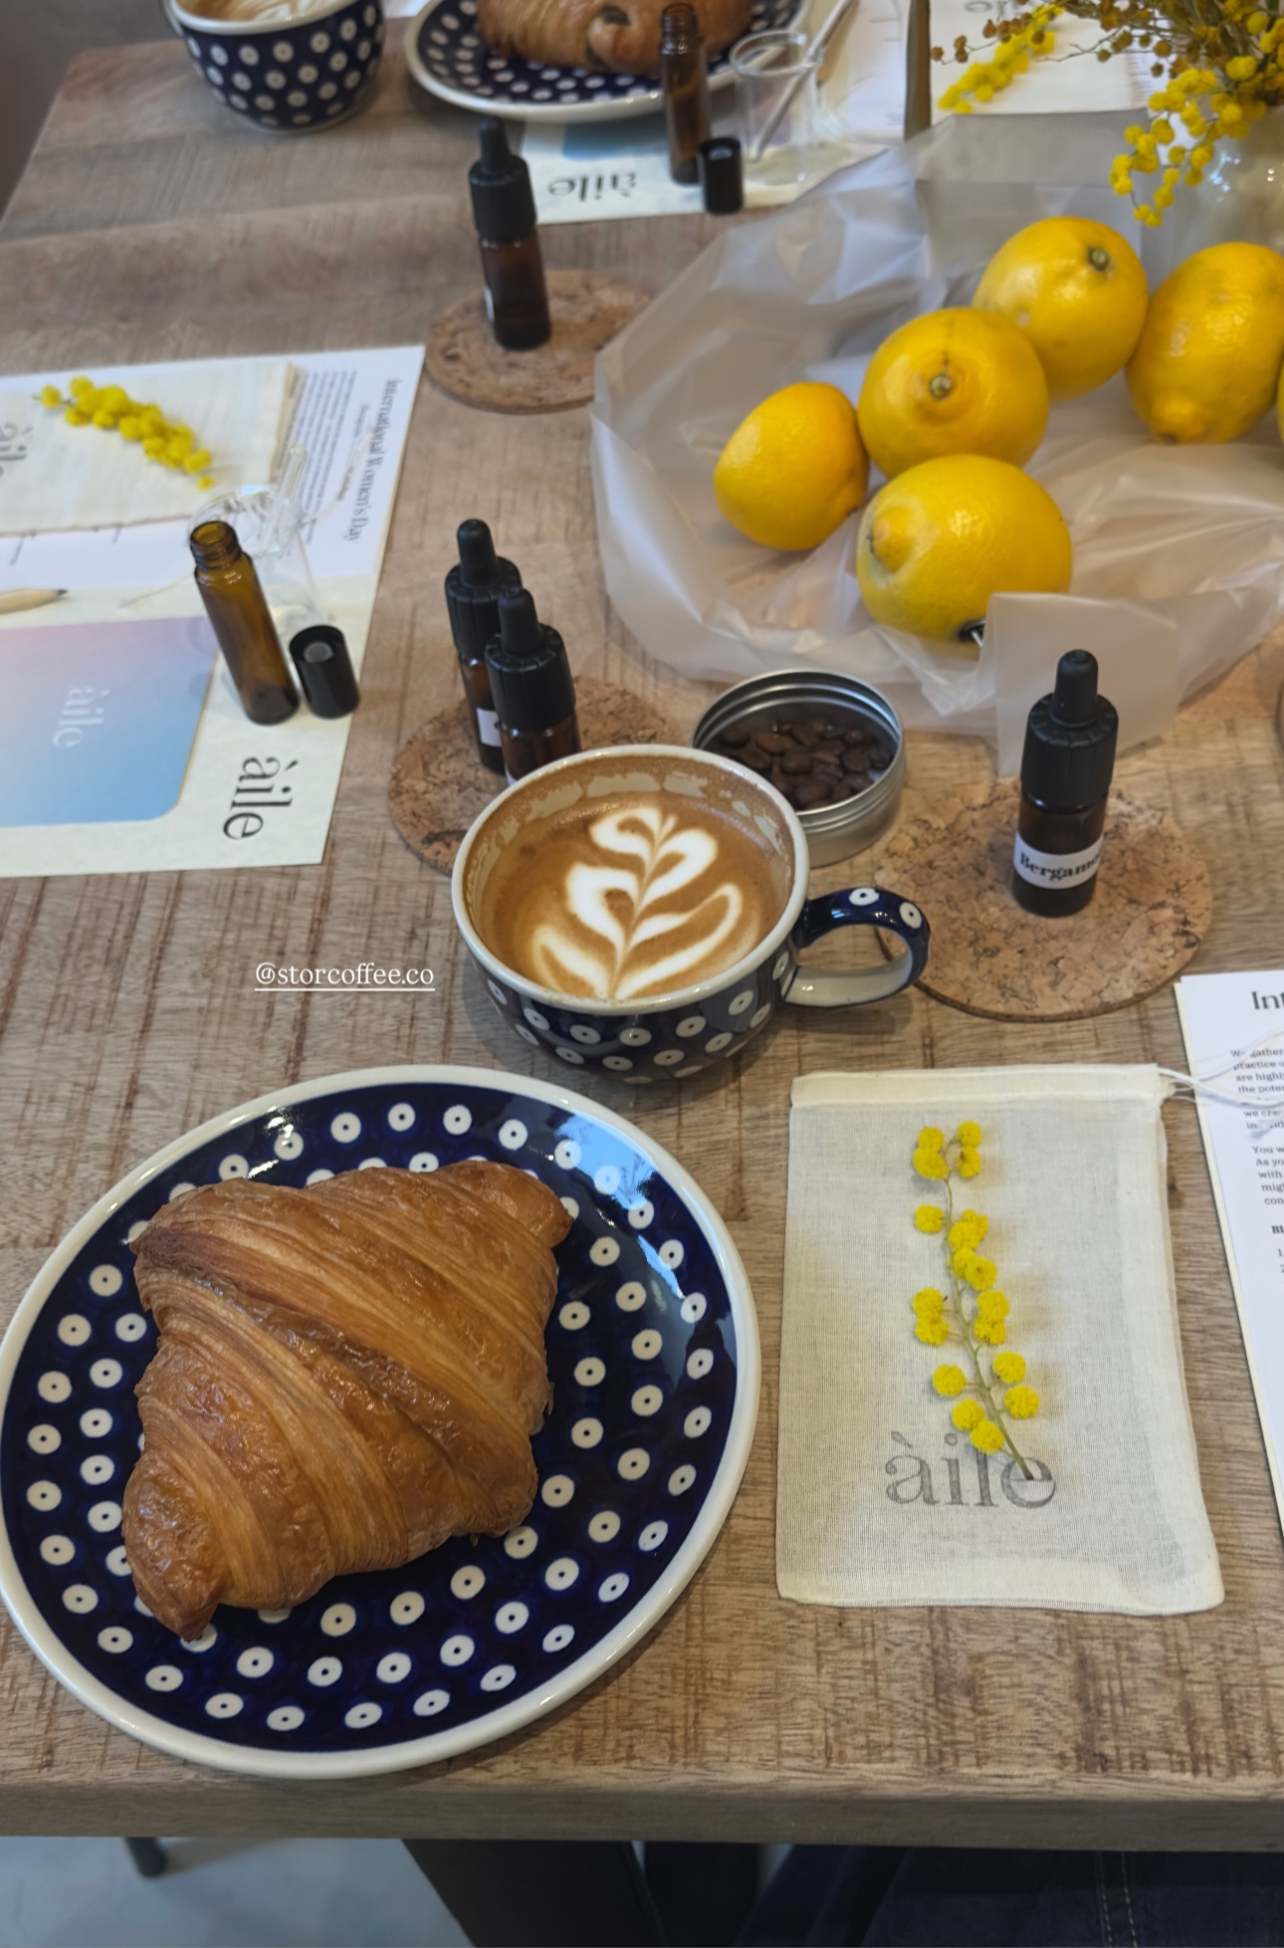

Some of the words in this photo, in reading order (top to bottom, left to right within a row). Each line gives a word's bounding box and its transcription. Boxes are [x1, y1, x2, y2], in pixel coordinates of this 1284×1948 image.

[369, 378, 403, 455] International
[353, 456, 384, 515] Women's
[344, 517, 370, 542] Day
[53, 687, 111, 748] àile
[223, 757, 299, 840] àile
[1236, 1074, 1253, 1082] are
[1255, 1071, 1284, 1082] highl
[1238, 1085, 1256, 1094] the
[1261, 1109, 1281, 1117] cre
[1252, 1145, 1274, 1154] You
[1256, 1158, 1269, 1166] As
[1258, 1170, 1283, 1179] with
[885, 1430, 1057, 1509] àile
